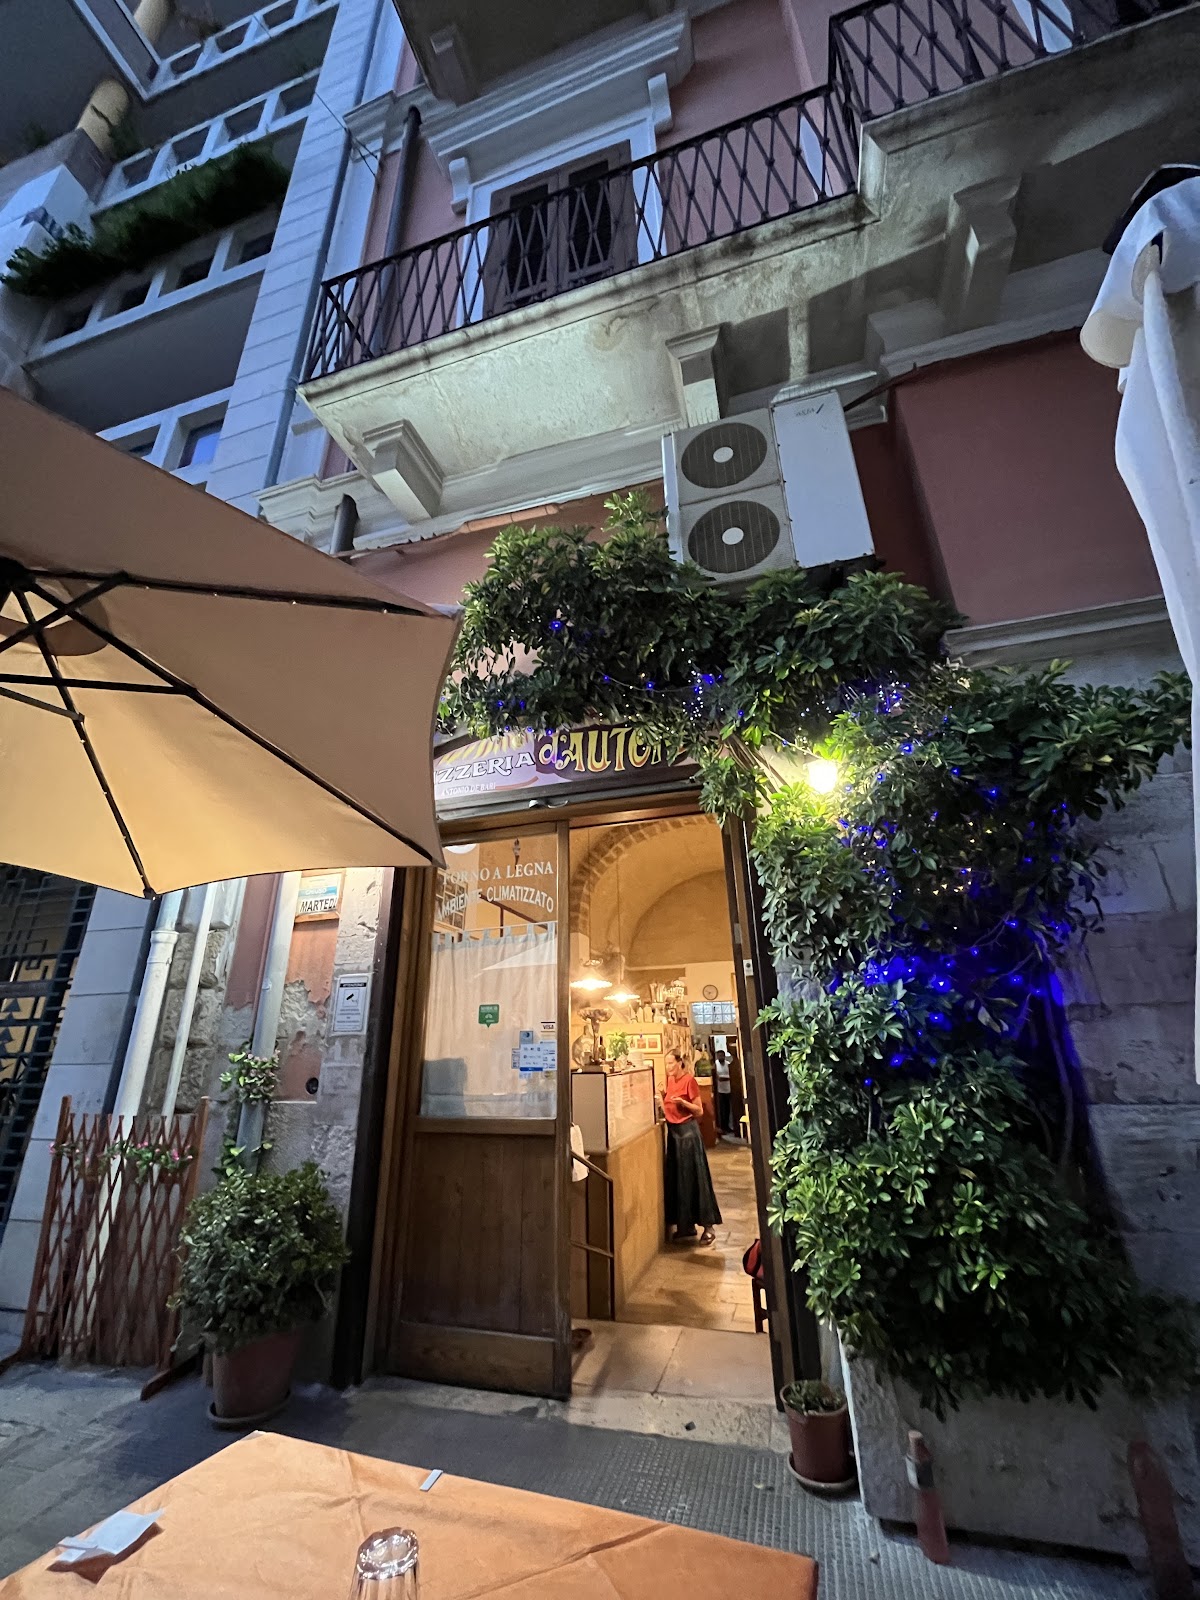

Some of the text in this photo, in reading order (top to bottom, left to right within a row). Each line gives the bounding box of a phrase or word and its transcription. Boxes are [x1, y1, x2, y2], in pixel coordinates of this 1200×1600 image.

[443, 861, 554, 885] FORNO A LEGNA
[437, 885, 554, 921] AMBIENTE CLIMATIZZATO
